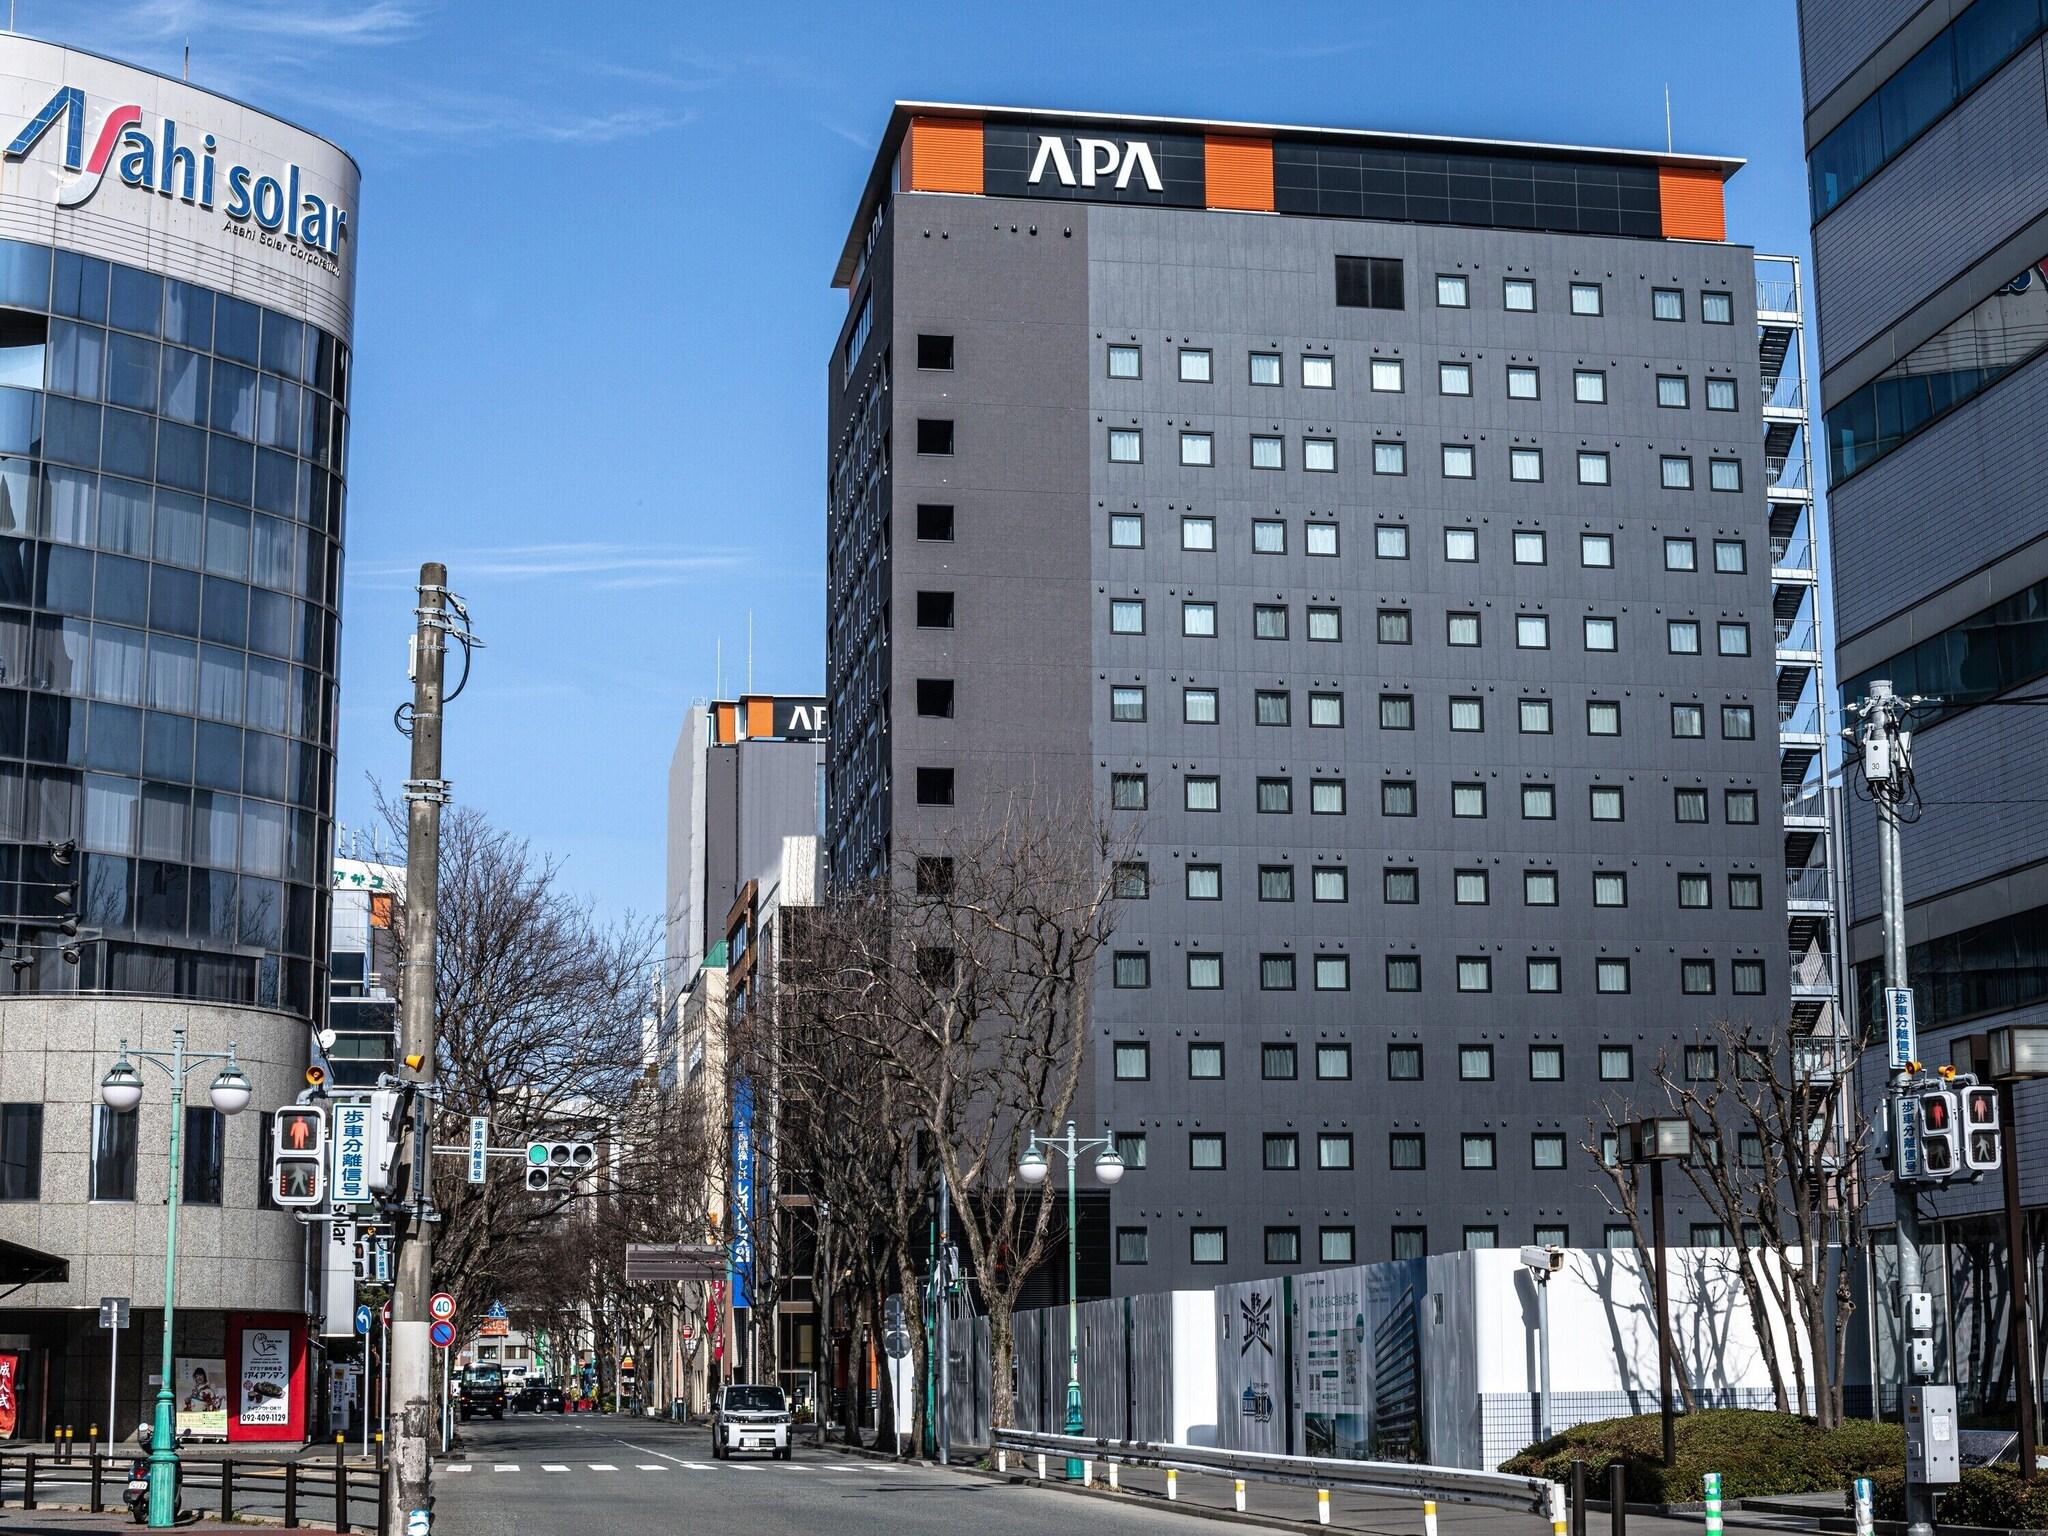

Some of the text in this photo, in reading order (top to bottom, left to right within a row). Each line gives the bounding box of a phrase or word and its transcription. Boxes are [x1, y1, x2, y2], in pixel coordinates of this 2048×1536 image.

[6, 85, 347, 257] Asahi solar
[1027, 135, 1163, 192] APA
[223, 220, 340, 278] Asahi Solar Corporation
[788, 705, 827, 731] AP
[1895, 993, 1911, 1063] 歩車分離信号
[341, 1110, 365, 1196] 歩車分離信号
[473, 1120, 483, 1180] 歩車分離信号
[1902, 1101, 1917, 1173] 歩車分離信号
[435, 1301, 450, 1313] 40
[242, 1413, 286, 1422] 092-409-1129
